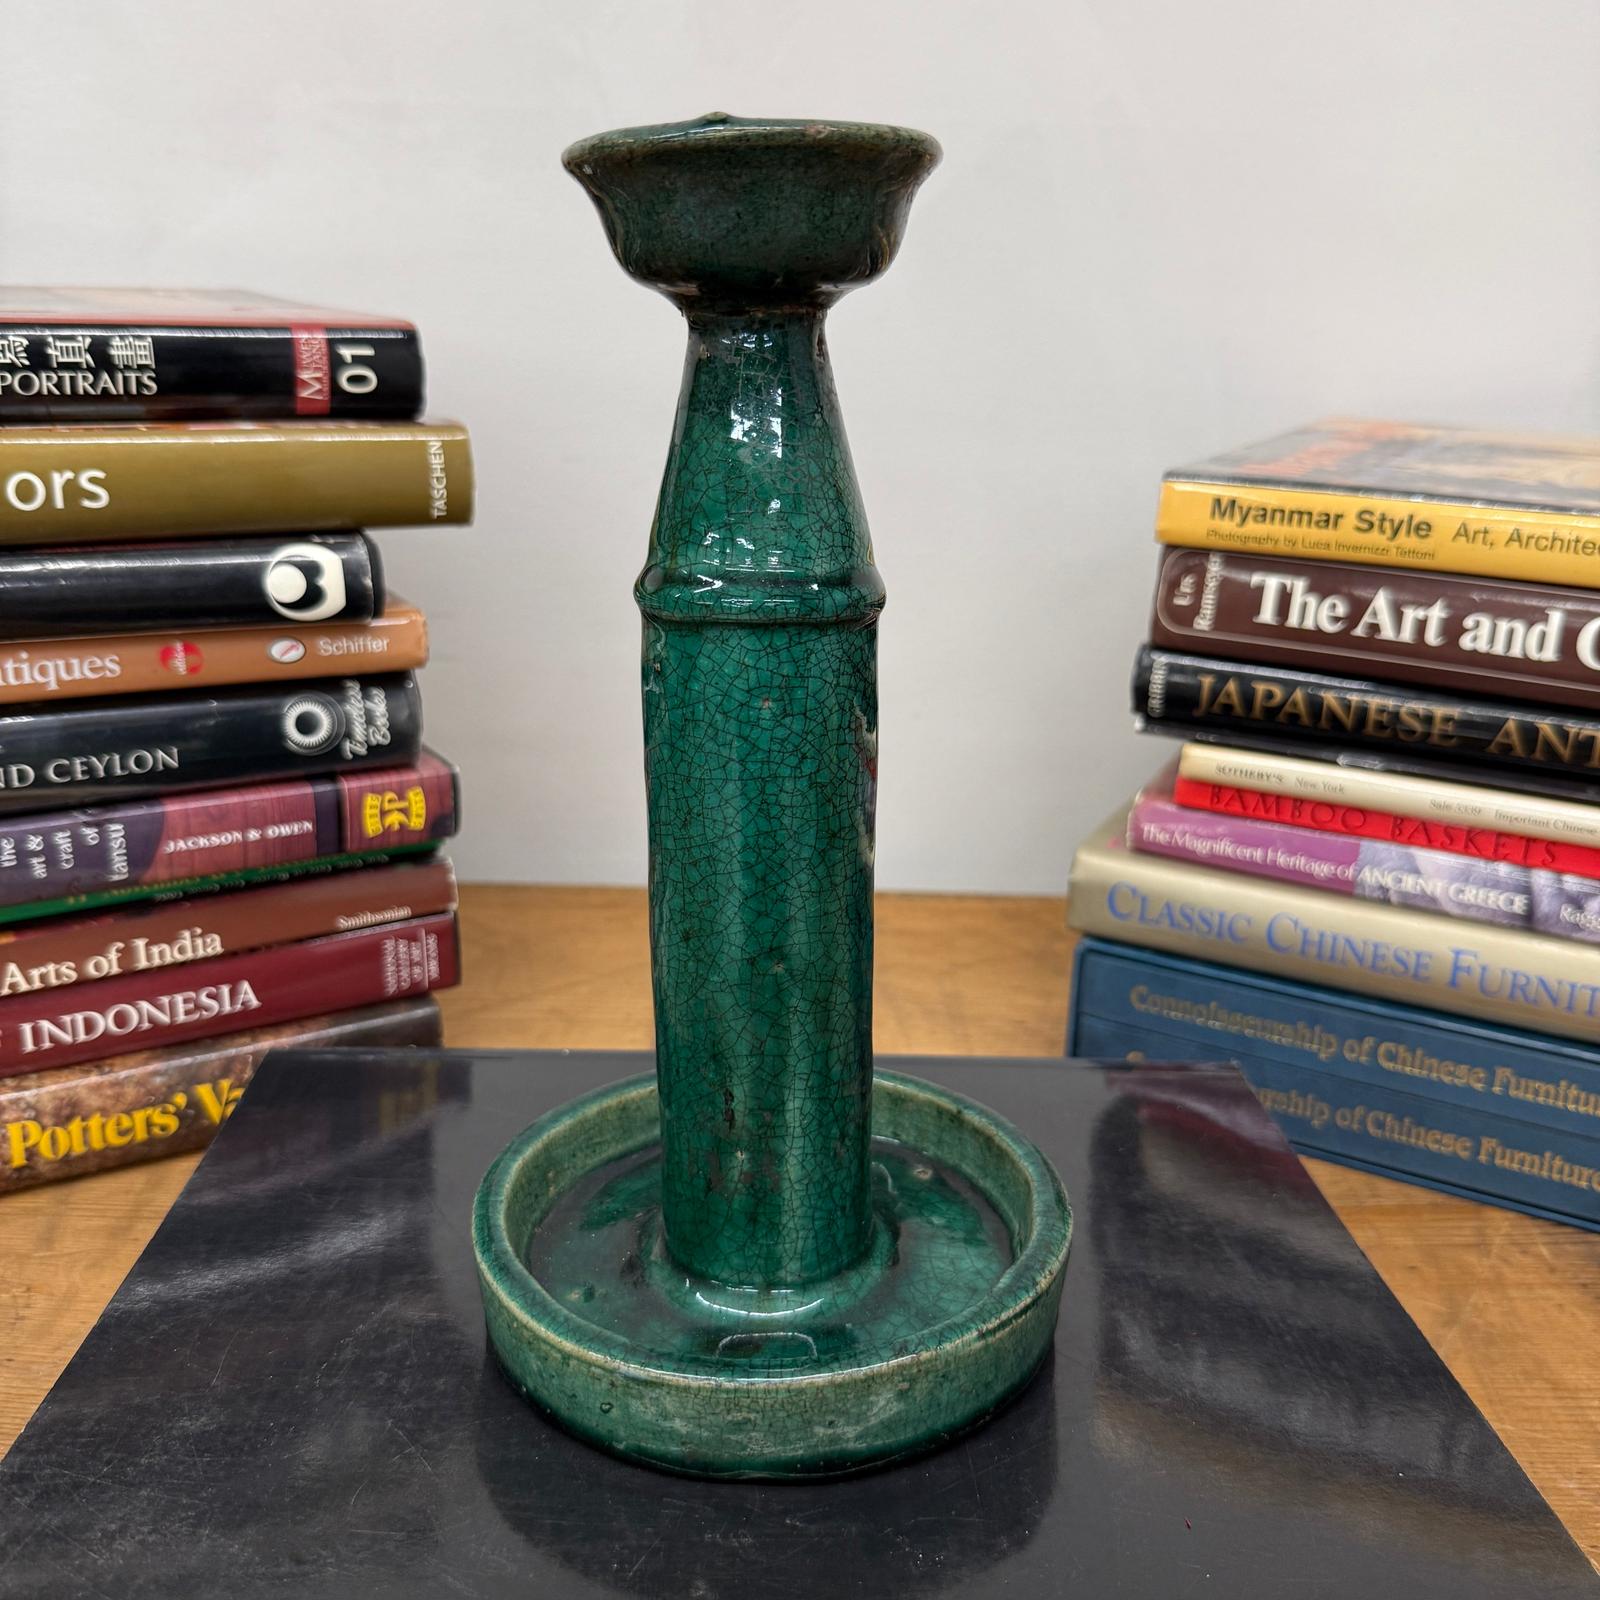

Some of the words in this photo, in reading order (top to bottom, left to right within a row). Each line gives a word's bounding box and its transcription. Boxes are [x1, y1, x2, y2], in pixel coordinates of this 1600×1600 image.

[0, 370, 157, 395] PORTRAITS
[335, 343, 378, 394] 01
[428, 440, 447, 518] TASCHEN
[1206, 529, 1280, 546] Photography
[1283, 535, 1297, 548] by
[1301, 537, 1332, 549] Luca
[1210, 496, 1344, 531] Myanmar
[1353, 508, 1433, 542] Style
[1452, 521, 1496, 550] Art,
[1504, 527, 1600, 556] Archite
[1250, 570, 1350, 634] The
[1351, 585, 1453, 647] Art
[1458, 607, 1567, 662] and
[0, 650, 121, 690] tiques
[319, 636, 391, 657] Schiffer
[1192, 673, 1457, 747] JAPANESE
[46, 746, 179, 783] CEYLON
[1208, 785, 1367, 832] BAMBOO
[1390, 816, 1556, 868] BASKETS
[1295, 777, 1317, 789] New
[1321, 781, 1344, 794] York
[1429, 799, 1451, 811] Sale
[1494, 809, 1550, 828] Important
[0, 836, 18, 868] the
[24, 834, 44, 852] &
[51, 829, 75, 870] craft
[80, 825, 100, 846] of
[104, 823, 129, 882] tansu
[163, 830, 243, 855] JACKSON
[245, 827, 262, 842] &
[265, 820, 313, 840] OWEN
[27, 854, 48, 880] art
[1143, 823, 1170, 845] The
[1171, 830, 1266, 864] Magnificent
[1266, 846, 1335, 880] Heritage
[1336, 864, 1354, 881] of
[1356, 864, 1444, 895] ANCIENT
[1448, 882, 1531, 916] GREECE
[1107, 880, 1252, 944] CLASSIC
[1266, 911, 1433, 982] CHINESE
[0, 962, 78, 996] Arts
[85, 942, 125, 979] of
[131, 927, 224, 972] India
[19, 979, 263, 1055] INDONESIA
[1343, 1035, 1378, 1065] of
[1377, 1042, 1488, 1092] Chinese
[6, 1091, 188, 1169] Potters'
[1335, 1104, 1368, 1133] of
[1366, 1109, 1473, 1161] Chinese
